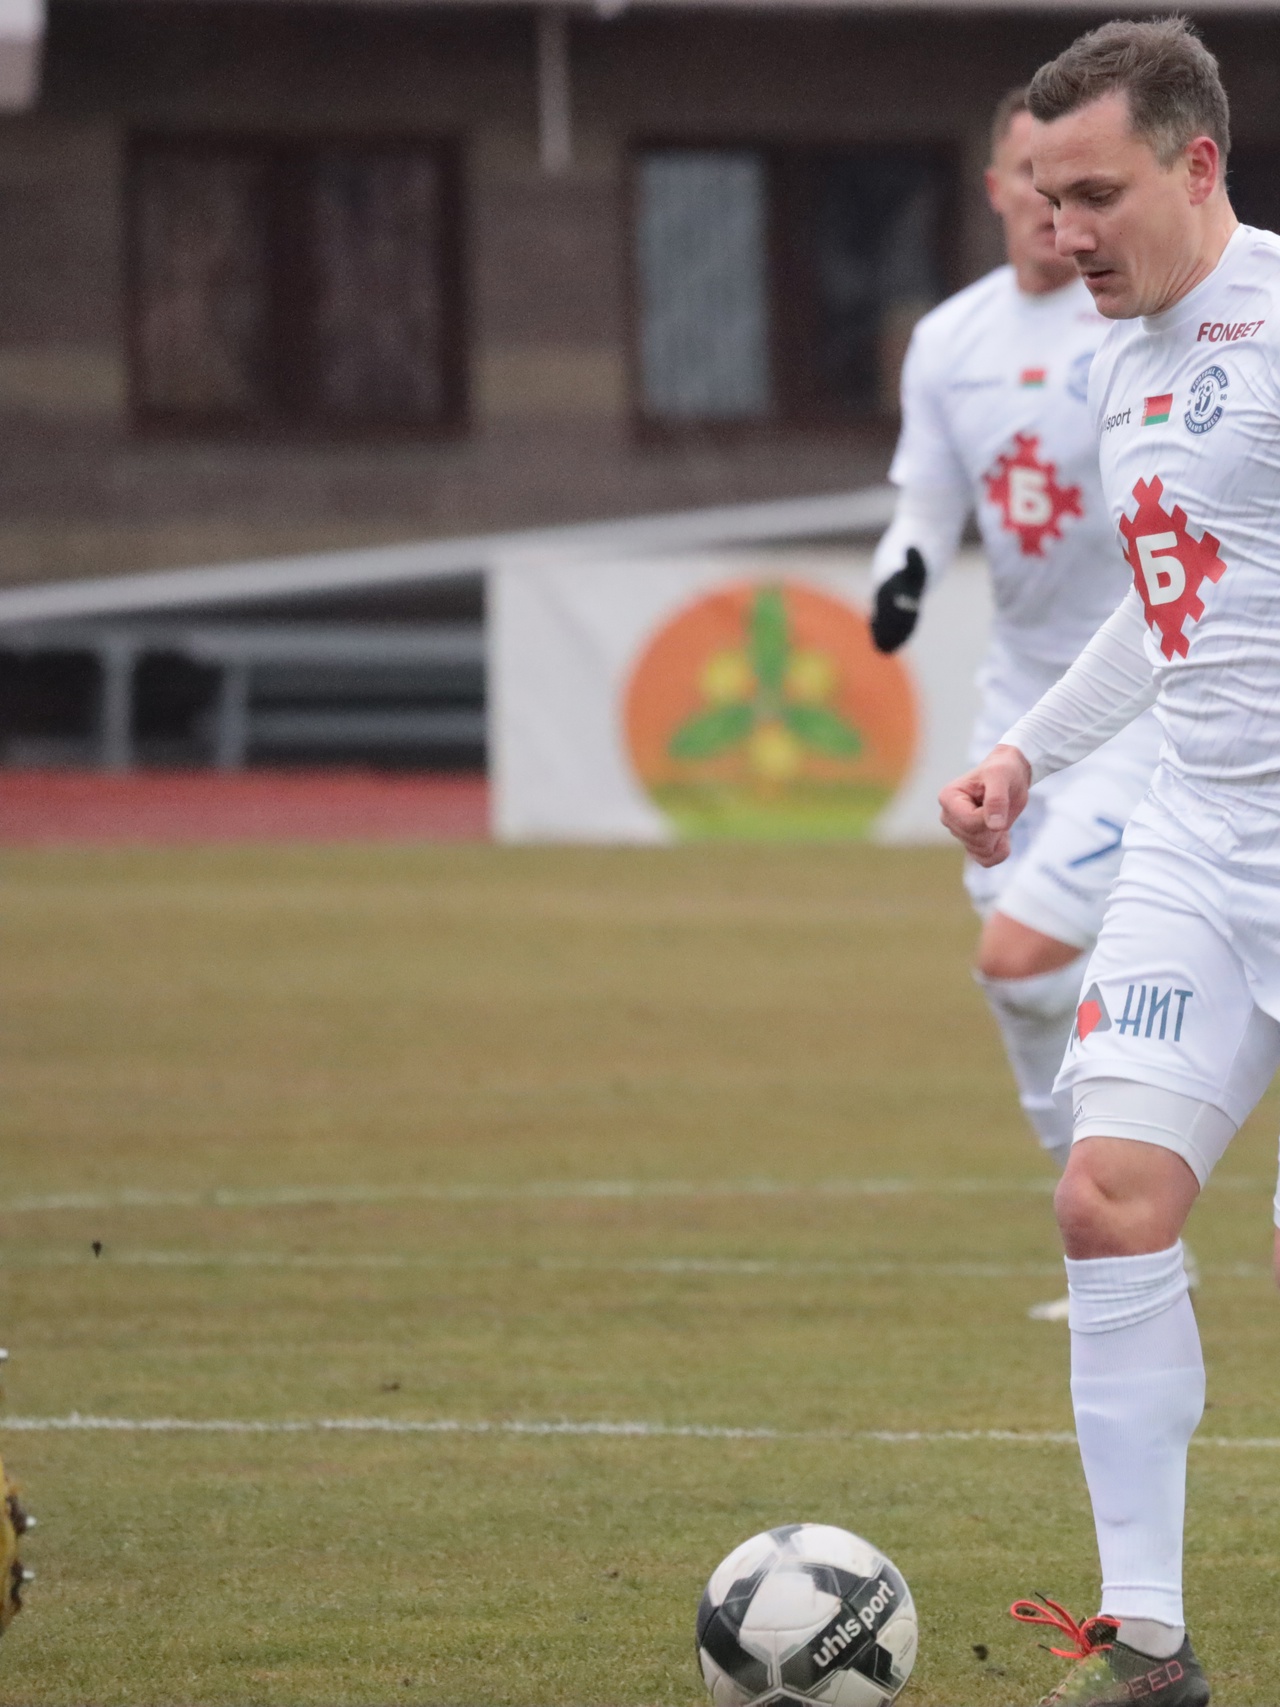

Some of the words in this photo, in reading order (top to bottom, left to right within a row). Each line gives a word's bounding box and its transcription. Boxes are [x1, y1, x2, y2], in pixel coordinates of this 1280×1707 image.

[1196, 319, 1266, 342] FONBET
[1102, 407, 1132, 433] sport
[1009, 467, 1053, 526] Б
[1136, 531, 1186, 606] Б
[812, 1579, 895, 1668] uhlsport
